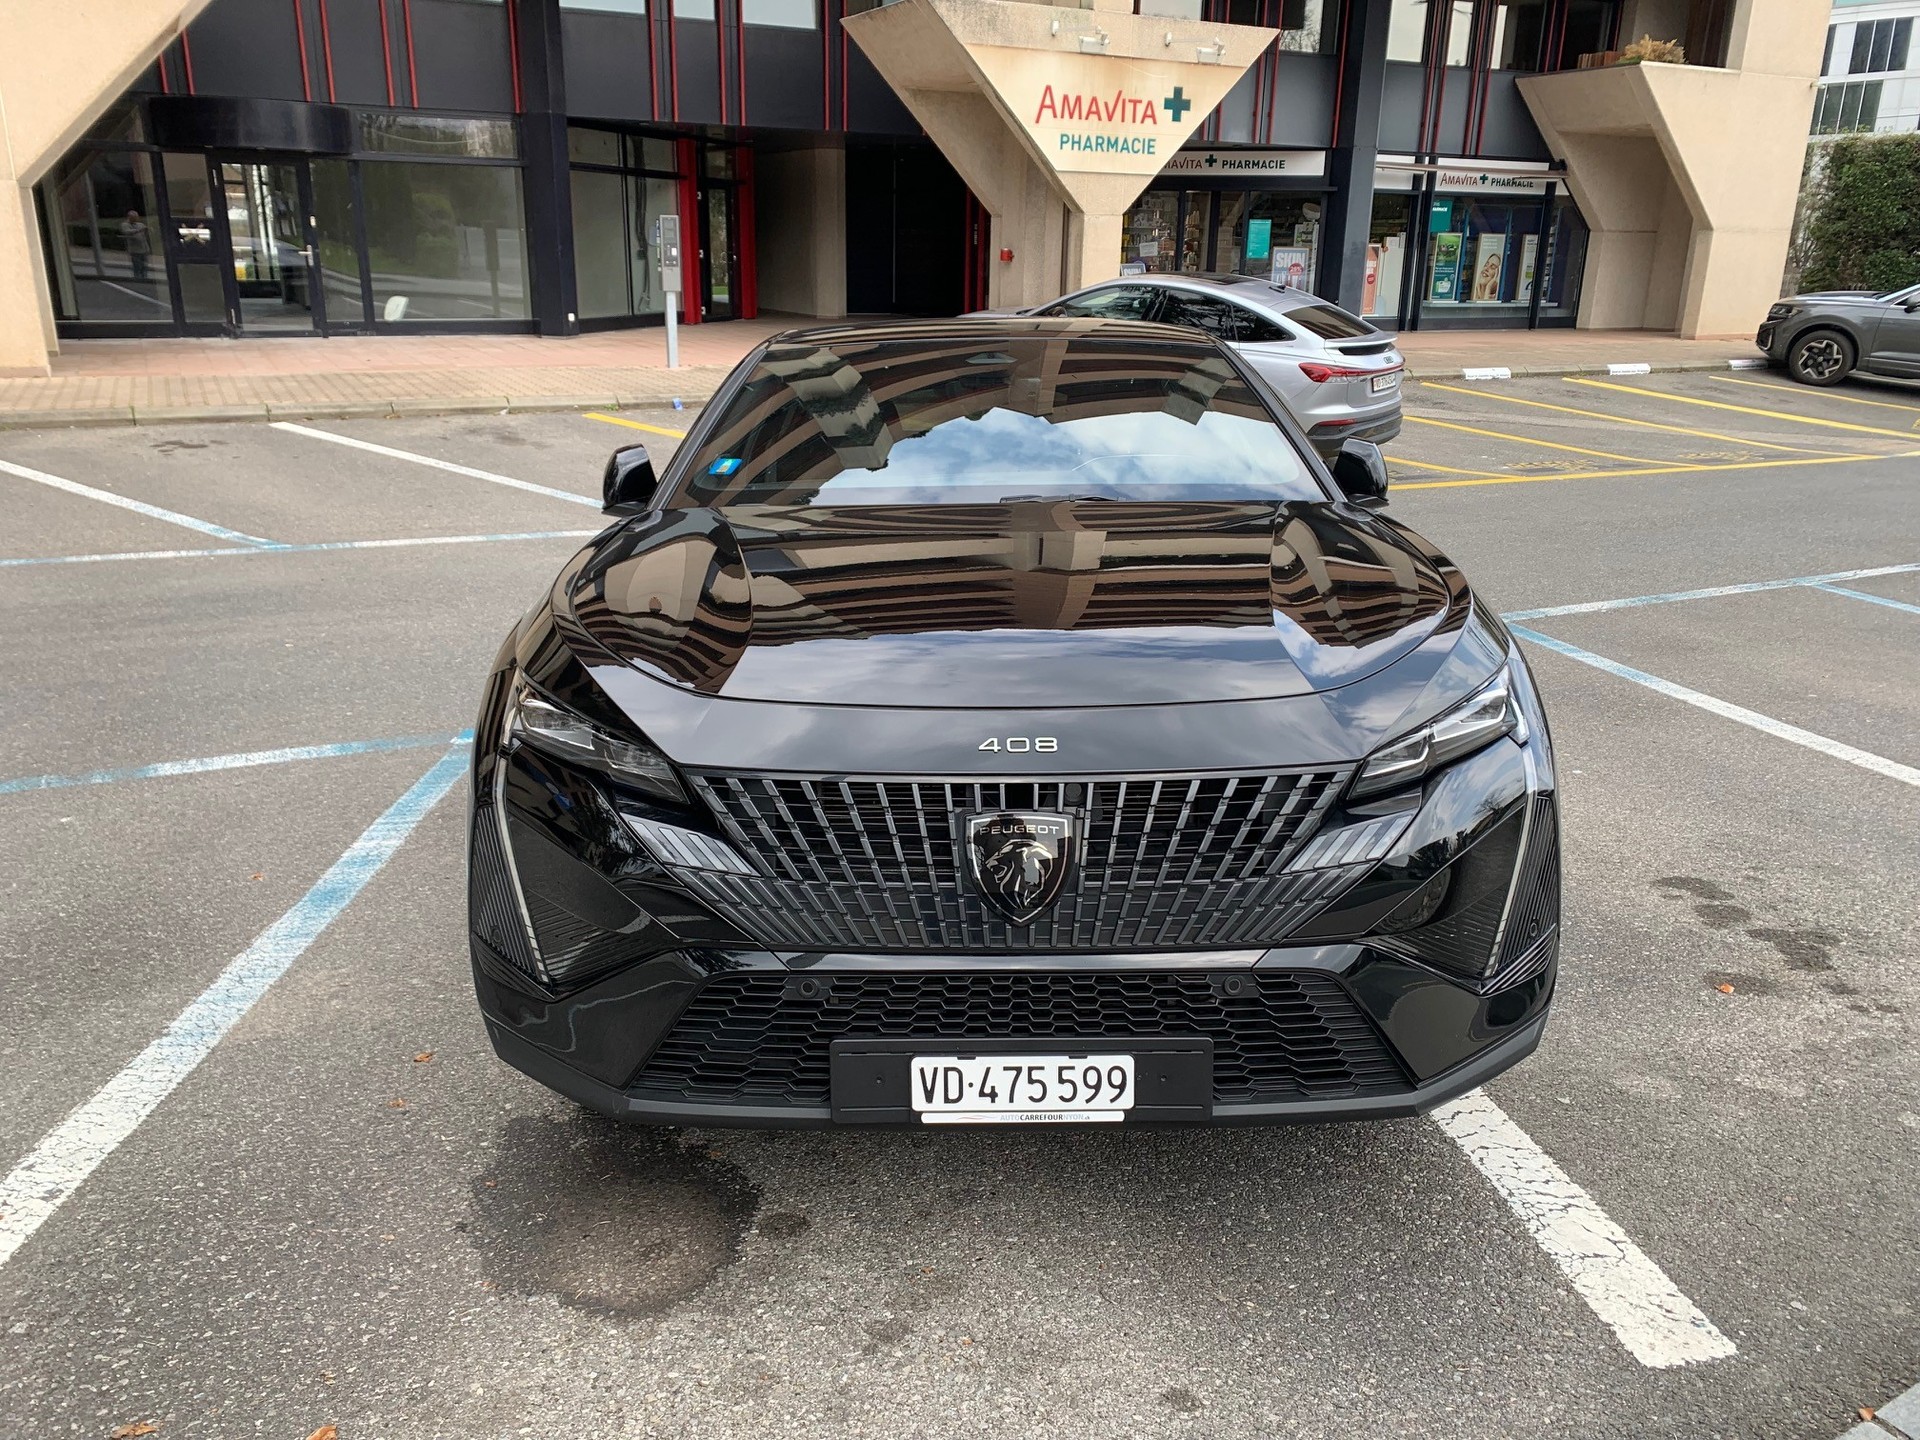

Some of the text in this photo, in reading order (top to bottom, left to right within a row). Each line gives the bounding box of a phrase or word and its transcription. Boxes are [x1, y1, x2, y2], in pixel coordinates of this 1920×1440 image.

[1035, 85, 1157, 125] AMAVITA
[1060, 133, 1156, 155] PHARMACIE
[1163, 157, 1286, 169] AVITA PHARMACIE
[978, 737, 1058, 752] 408
[979, 825, 1060, 835] PEUGEOT
